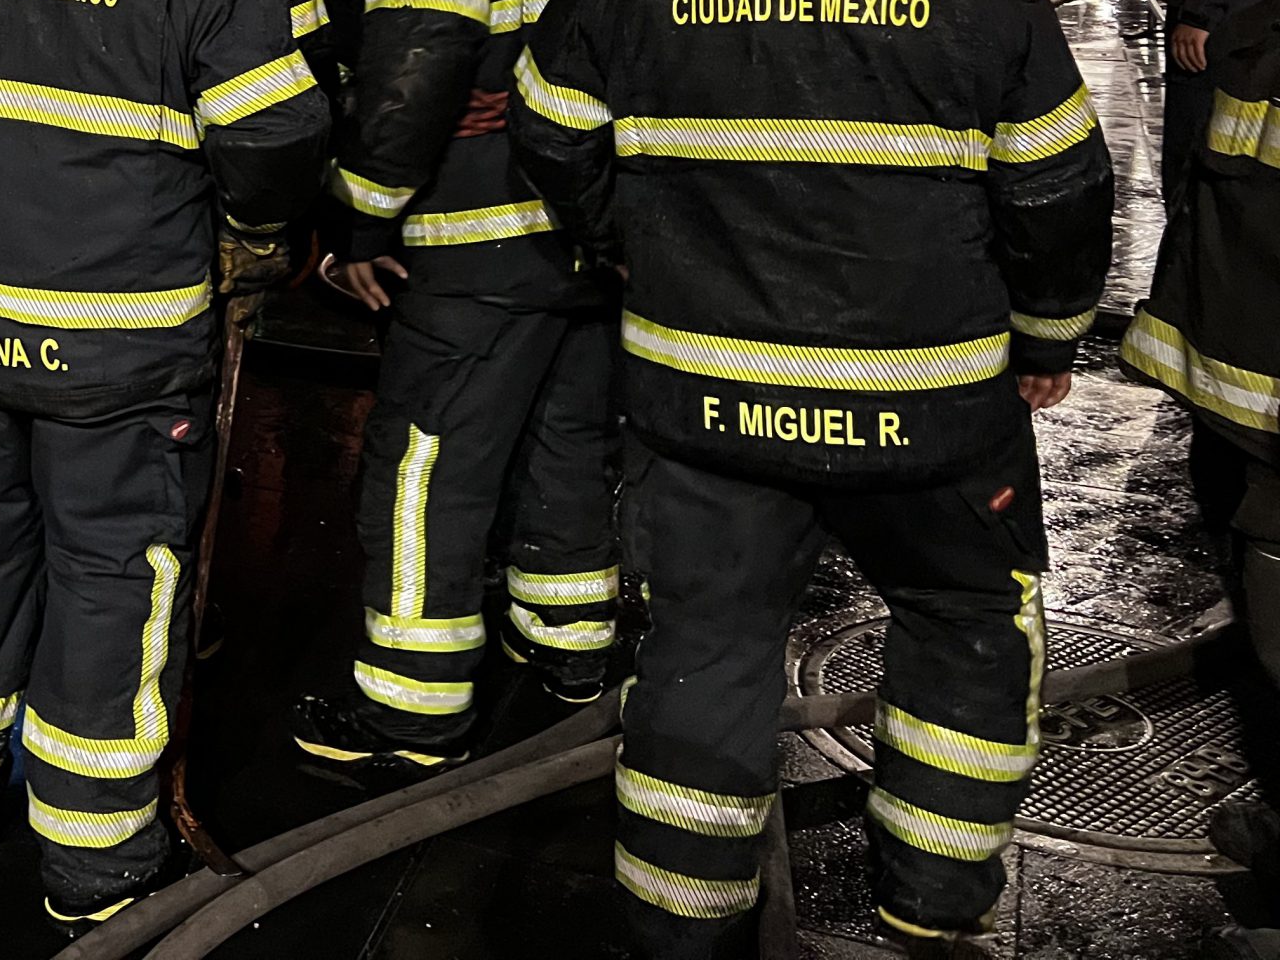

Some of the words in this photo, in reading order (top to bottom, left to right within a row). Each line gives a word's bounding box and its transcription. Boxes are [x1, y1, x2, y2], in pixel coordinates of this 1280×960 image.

[40, 338, 69, 371] C.
[703, 395, 725, 432] F.
[738, 401, 866, 446] MIGUEL
[878, 411, 910, 447] R.
